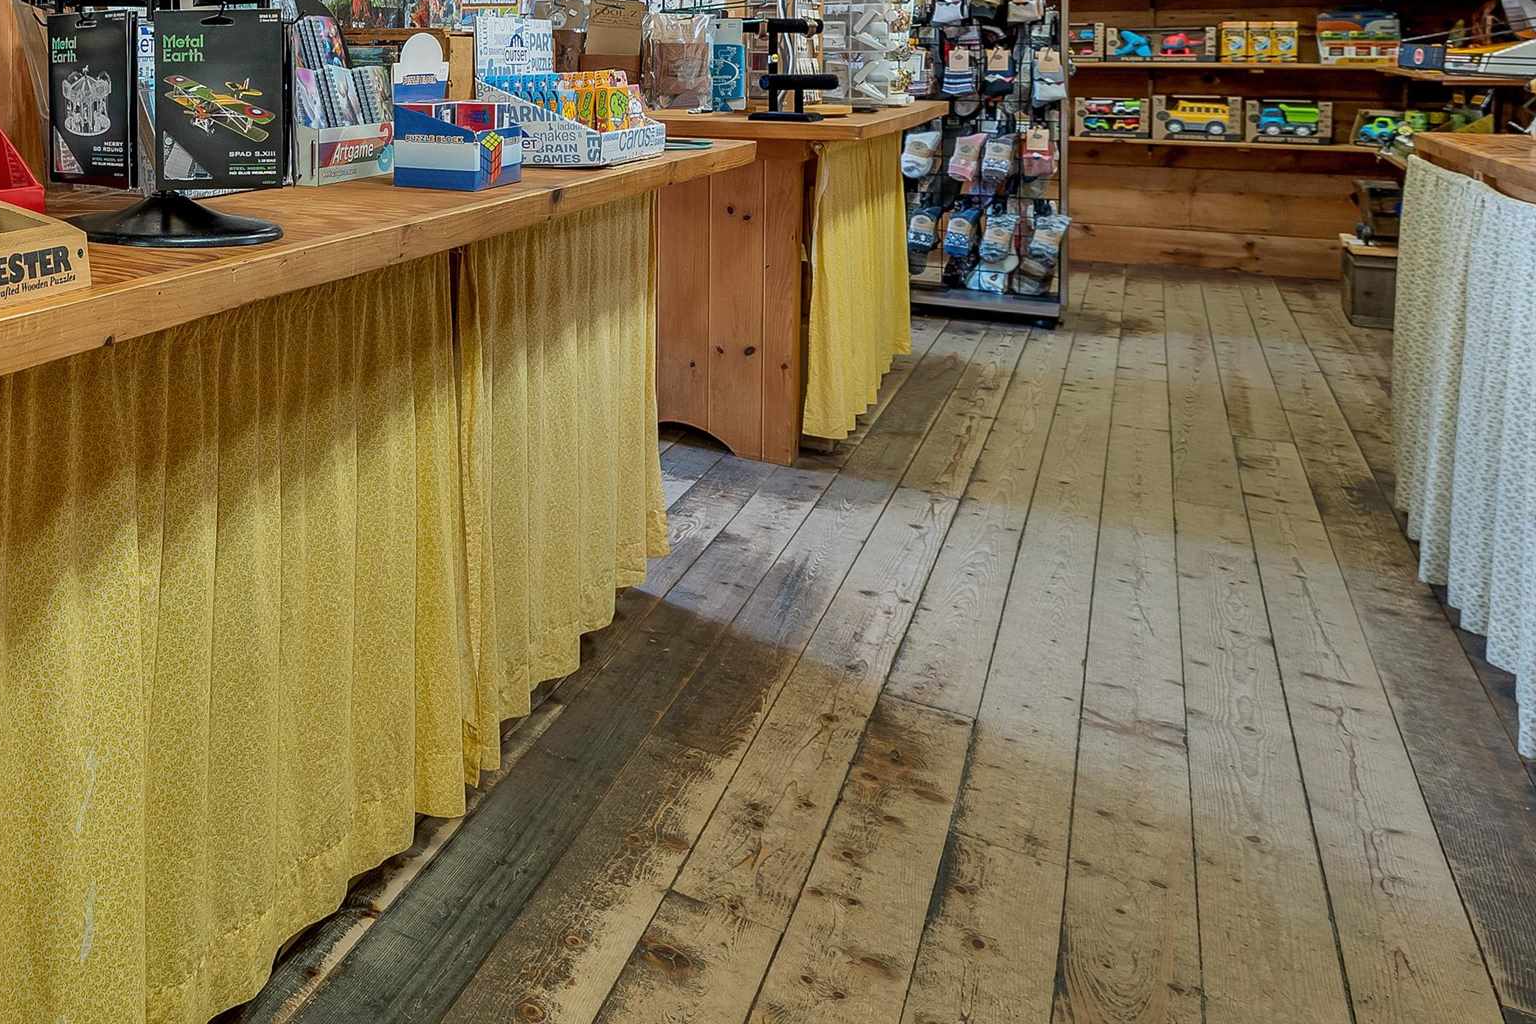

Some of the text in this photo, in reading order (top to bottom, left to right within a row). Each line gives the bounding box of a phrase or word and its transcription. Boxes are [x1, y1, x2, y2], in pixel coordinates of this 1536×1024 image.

[52, 36, 77, 50] Metal
[163, 34, 204, 49] Metal
[52, 50, 77, 64] Earth
[163, 49, 205, 63] Earth
[404, 134, 464, 144] PUZZLE BLOCK
[533, 131, 576, 142] snakes
[619, 128, 651, 151] cards
[332, 142, 374, 165] Artgame
[532, 155, 581, 164] GAMES
[21, 277, 49, 293] Wooden
[50, 273, 76, 287] Puzzles
